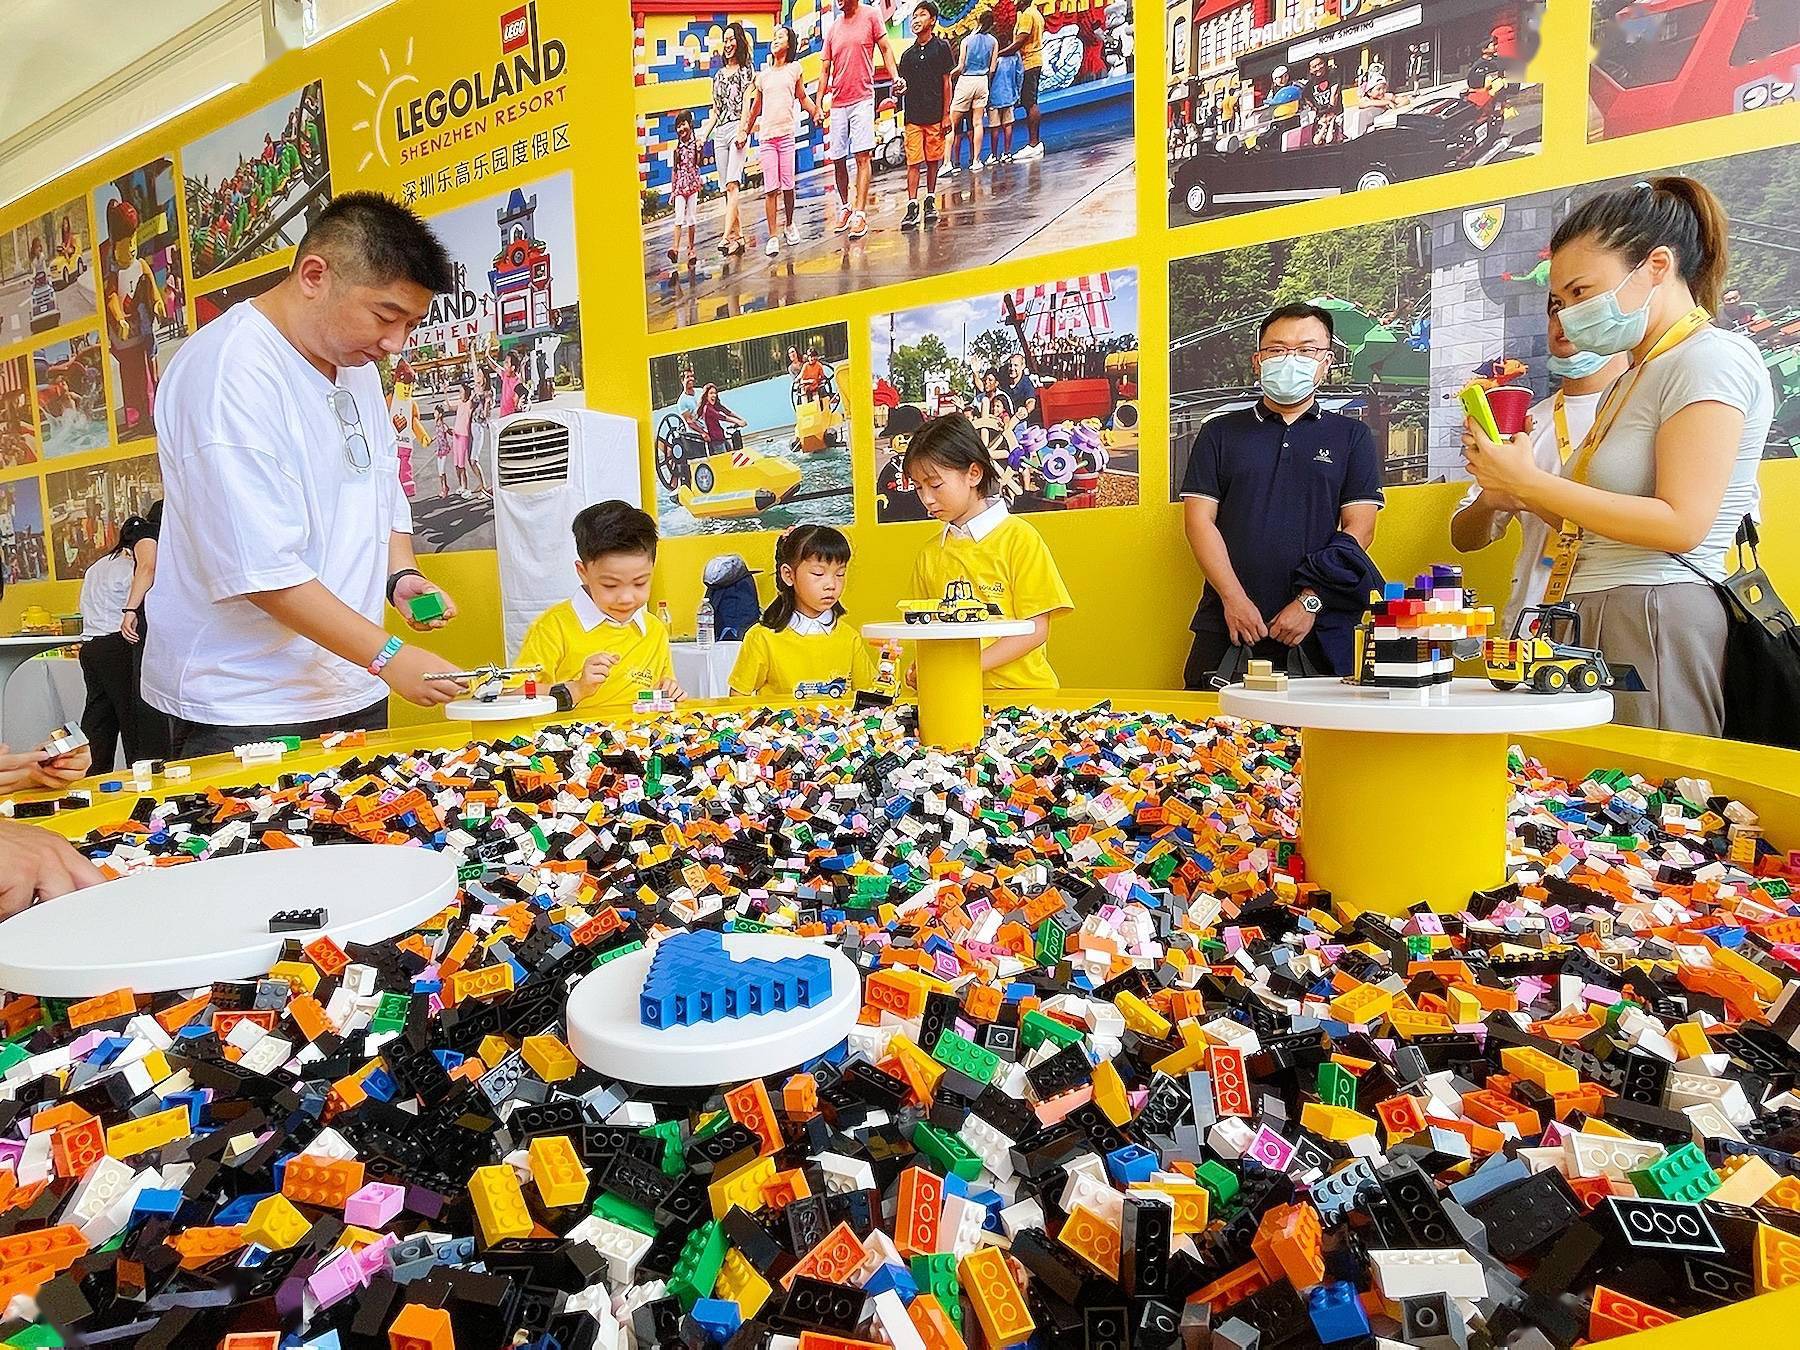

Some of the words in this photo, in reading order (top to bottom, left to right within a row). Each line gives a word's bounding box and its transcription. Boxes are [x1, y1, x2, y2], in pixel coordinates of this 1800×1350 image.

[503, 18, 526, 42] LEGO
[1250, 7, 1317, 46] PALACE
[396, 1, 566, 141] LEGOLAND
[400, 117, 487, 165] SHENZHEN
[495, 85, 566, 127] RESORT
[402, 123, 570, 204] 深圳乐高乐园度假区
[420, 261, 477, 329] AND
